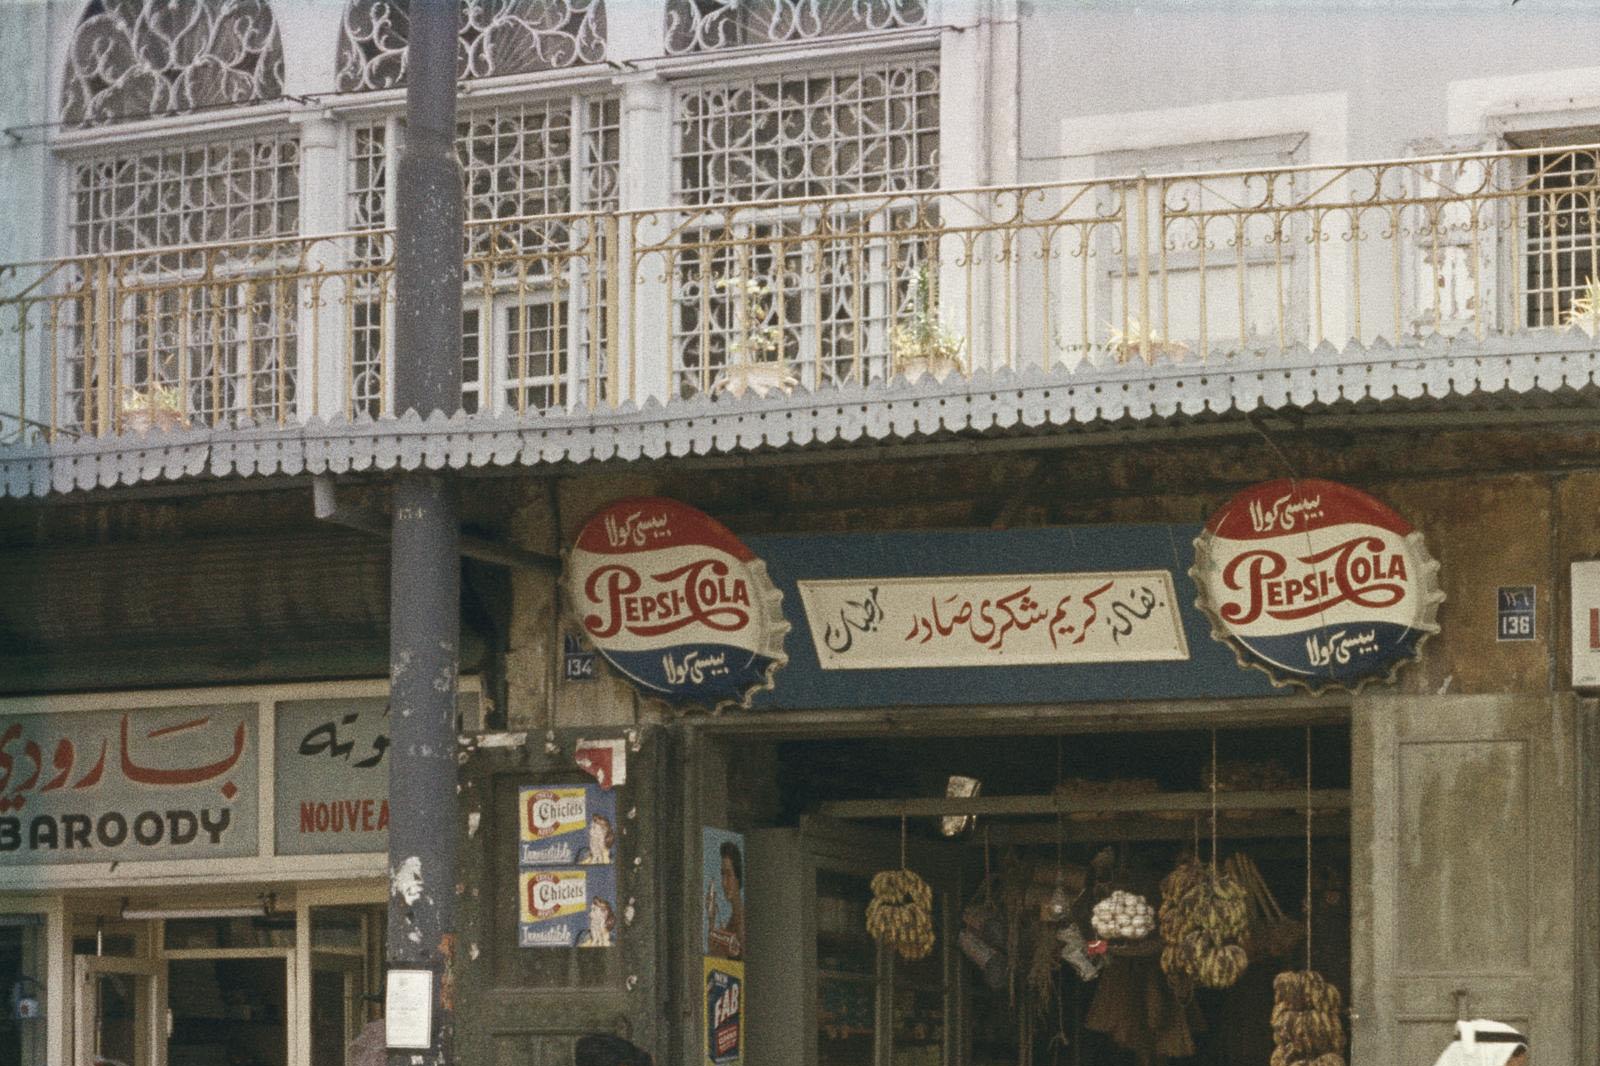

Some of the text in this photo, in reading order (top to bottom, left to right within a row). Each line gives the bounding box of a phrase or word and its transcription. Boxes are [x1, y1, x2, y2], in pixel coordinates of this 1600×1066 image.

[905, 593, 973, 644] صادر
[0, 808, 231, 850] BAROODY
[714, 983, 740, 1029] FAB
